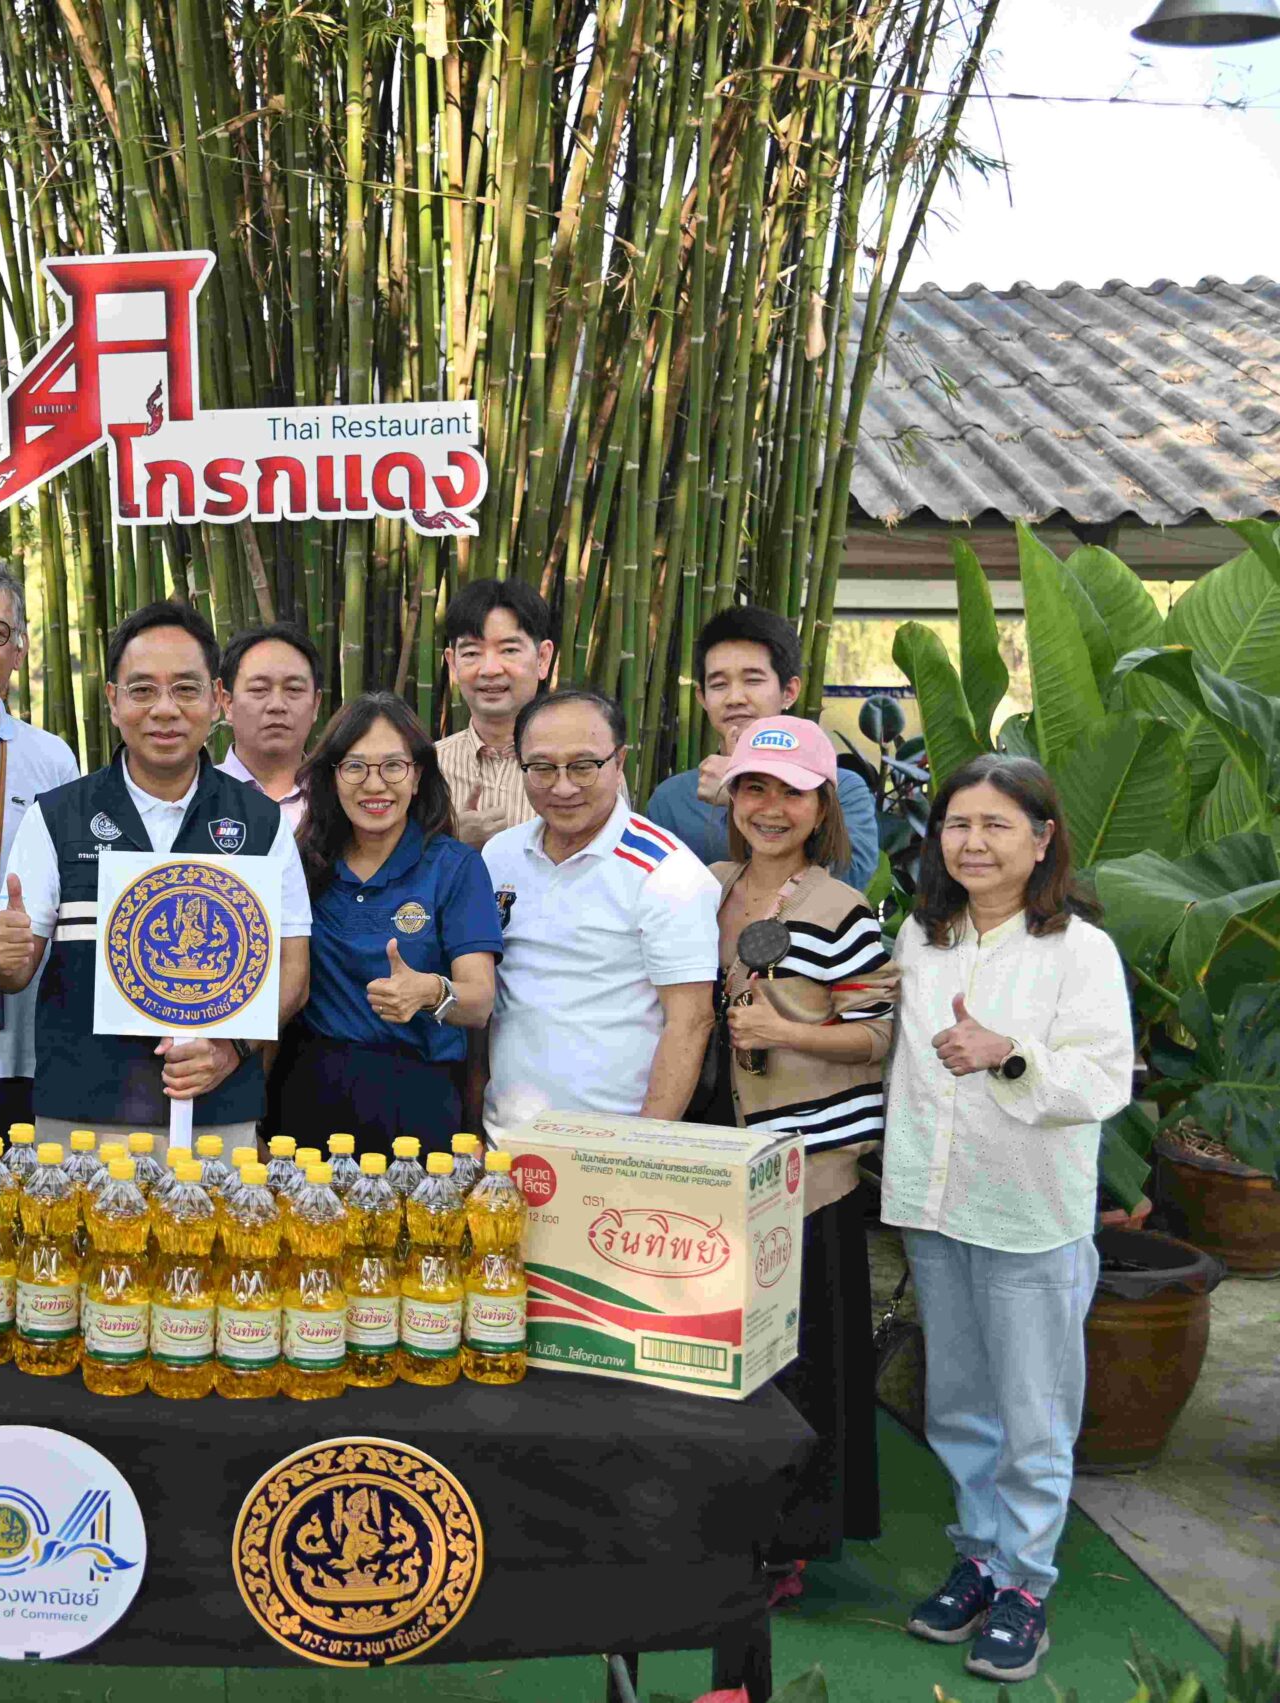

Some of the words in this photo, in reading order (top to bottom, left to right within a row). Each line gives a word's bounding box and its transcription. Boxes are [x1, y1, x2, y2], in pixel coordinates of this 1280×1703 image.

[267, 416, 320, 441] Thai
[332, 412, 472, 439] Restaurant
[752, 733, 793, 748] emis
[143, 995, 231, 1021] กระทรวงพาณิชย์
[512, 1167, 523, 1191] 1
[524, 1168, 550, 1180] ขนาด
[581, 1164, 613, 1175] REFINED
[616, 1168, 637, 1177] PALM
[640, 1171, 663, 1180] OLEIN
[665, 1173, 689, 1183] FROM
[692, 1176, 732, 1187] PERICARP
[524, 1178, 551, 1195] ลิตร
[582, 1195, 605, 1207] ตรา
[528, 1212, 539, 1222] 12
[542, 1214, 560, 1224] ขวด
[600, 1208, 723, 1264] รินทิพย์
[3, 1607, 16, 1618] of
[20, 1608, 89, 1622] Commerce
[299, 1616, 431, 1656] กระทรวงพาณิชย์
